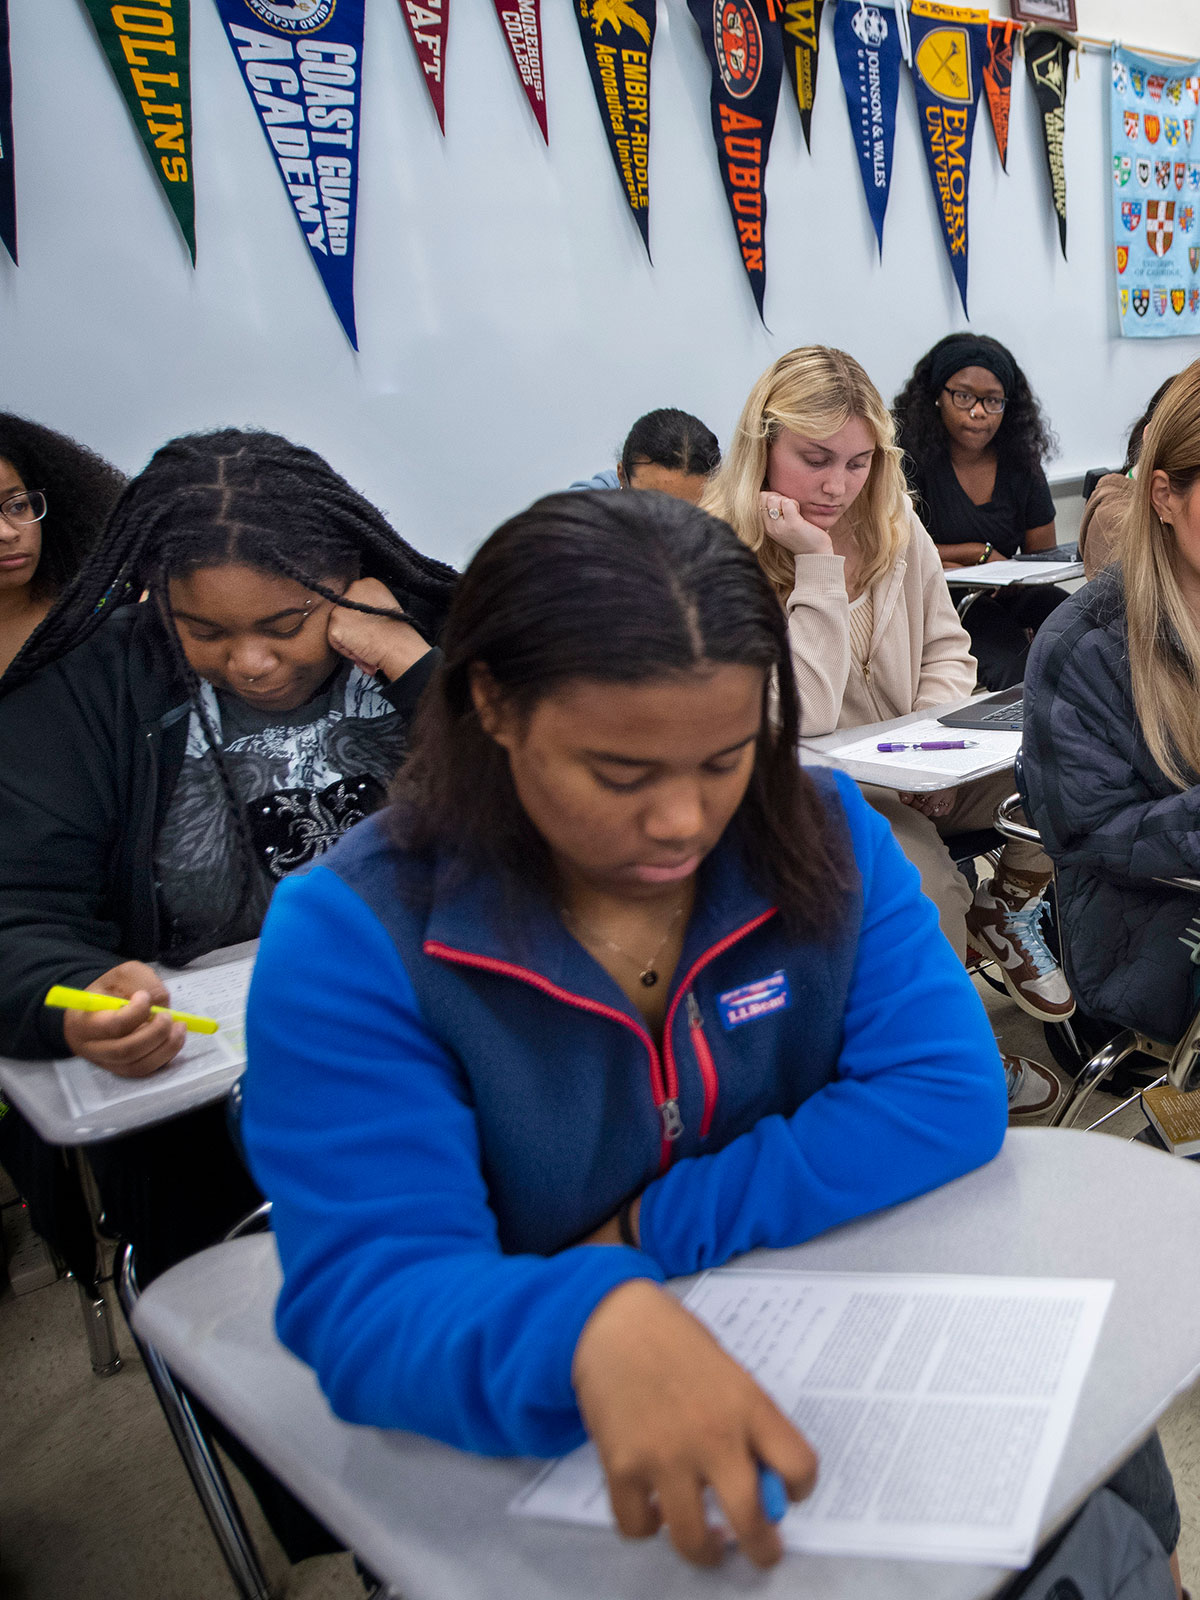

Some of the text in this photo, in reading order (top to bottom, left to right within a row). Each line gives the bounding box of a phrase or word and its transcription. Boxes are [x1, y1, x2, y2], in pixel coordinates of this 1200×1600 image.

[110, 0, 188, 182] OLLINS
[299, 3, 329, 29] GUARD
[404, 0, 442, 83] AFT
[502, 10, 534, 87] COLLEGE
[740, 7, 758, 81] AUBURN
[784, 0, 817, 52] W
[228, 22, 328, 256] ACADEMY
[296, 39, 357, 256] COAST GUARD
[594, 42, 640, 210] Aeronautical University
[621, 48, 650, 208] EMBRY-RIDDLE
[857, 48, 871, 159] UNIVERSITY
[865, 48, 887, 188] JOHNSON & WALES
[718, 103, 764, 273] AUBURN
[925, 105, 959, 256] UNIVERSITY
[942, 106, 968, 257] EMORY
